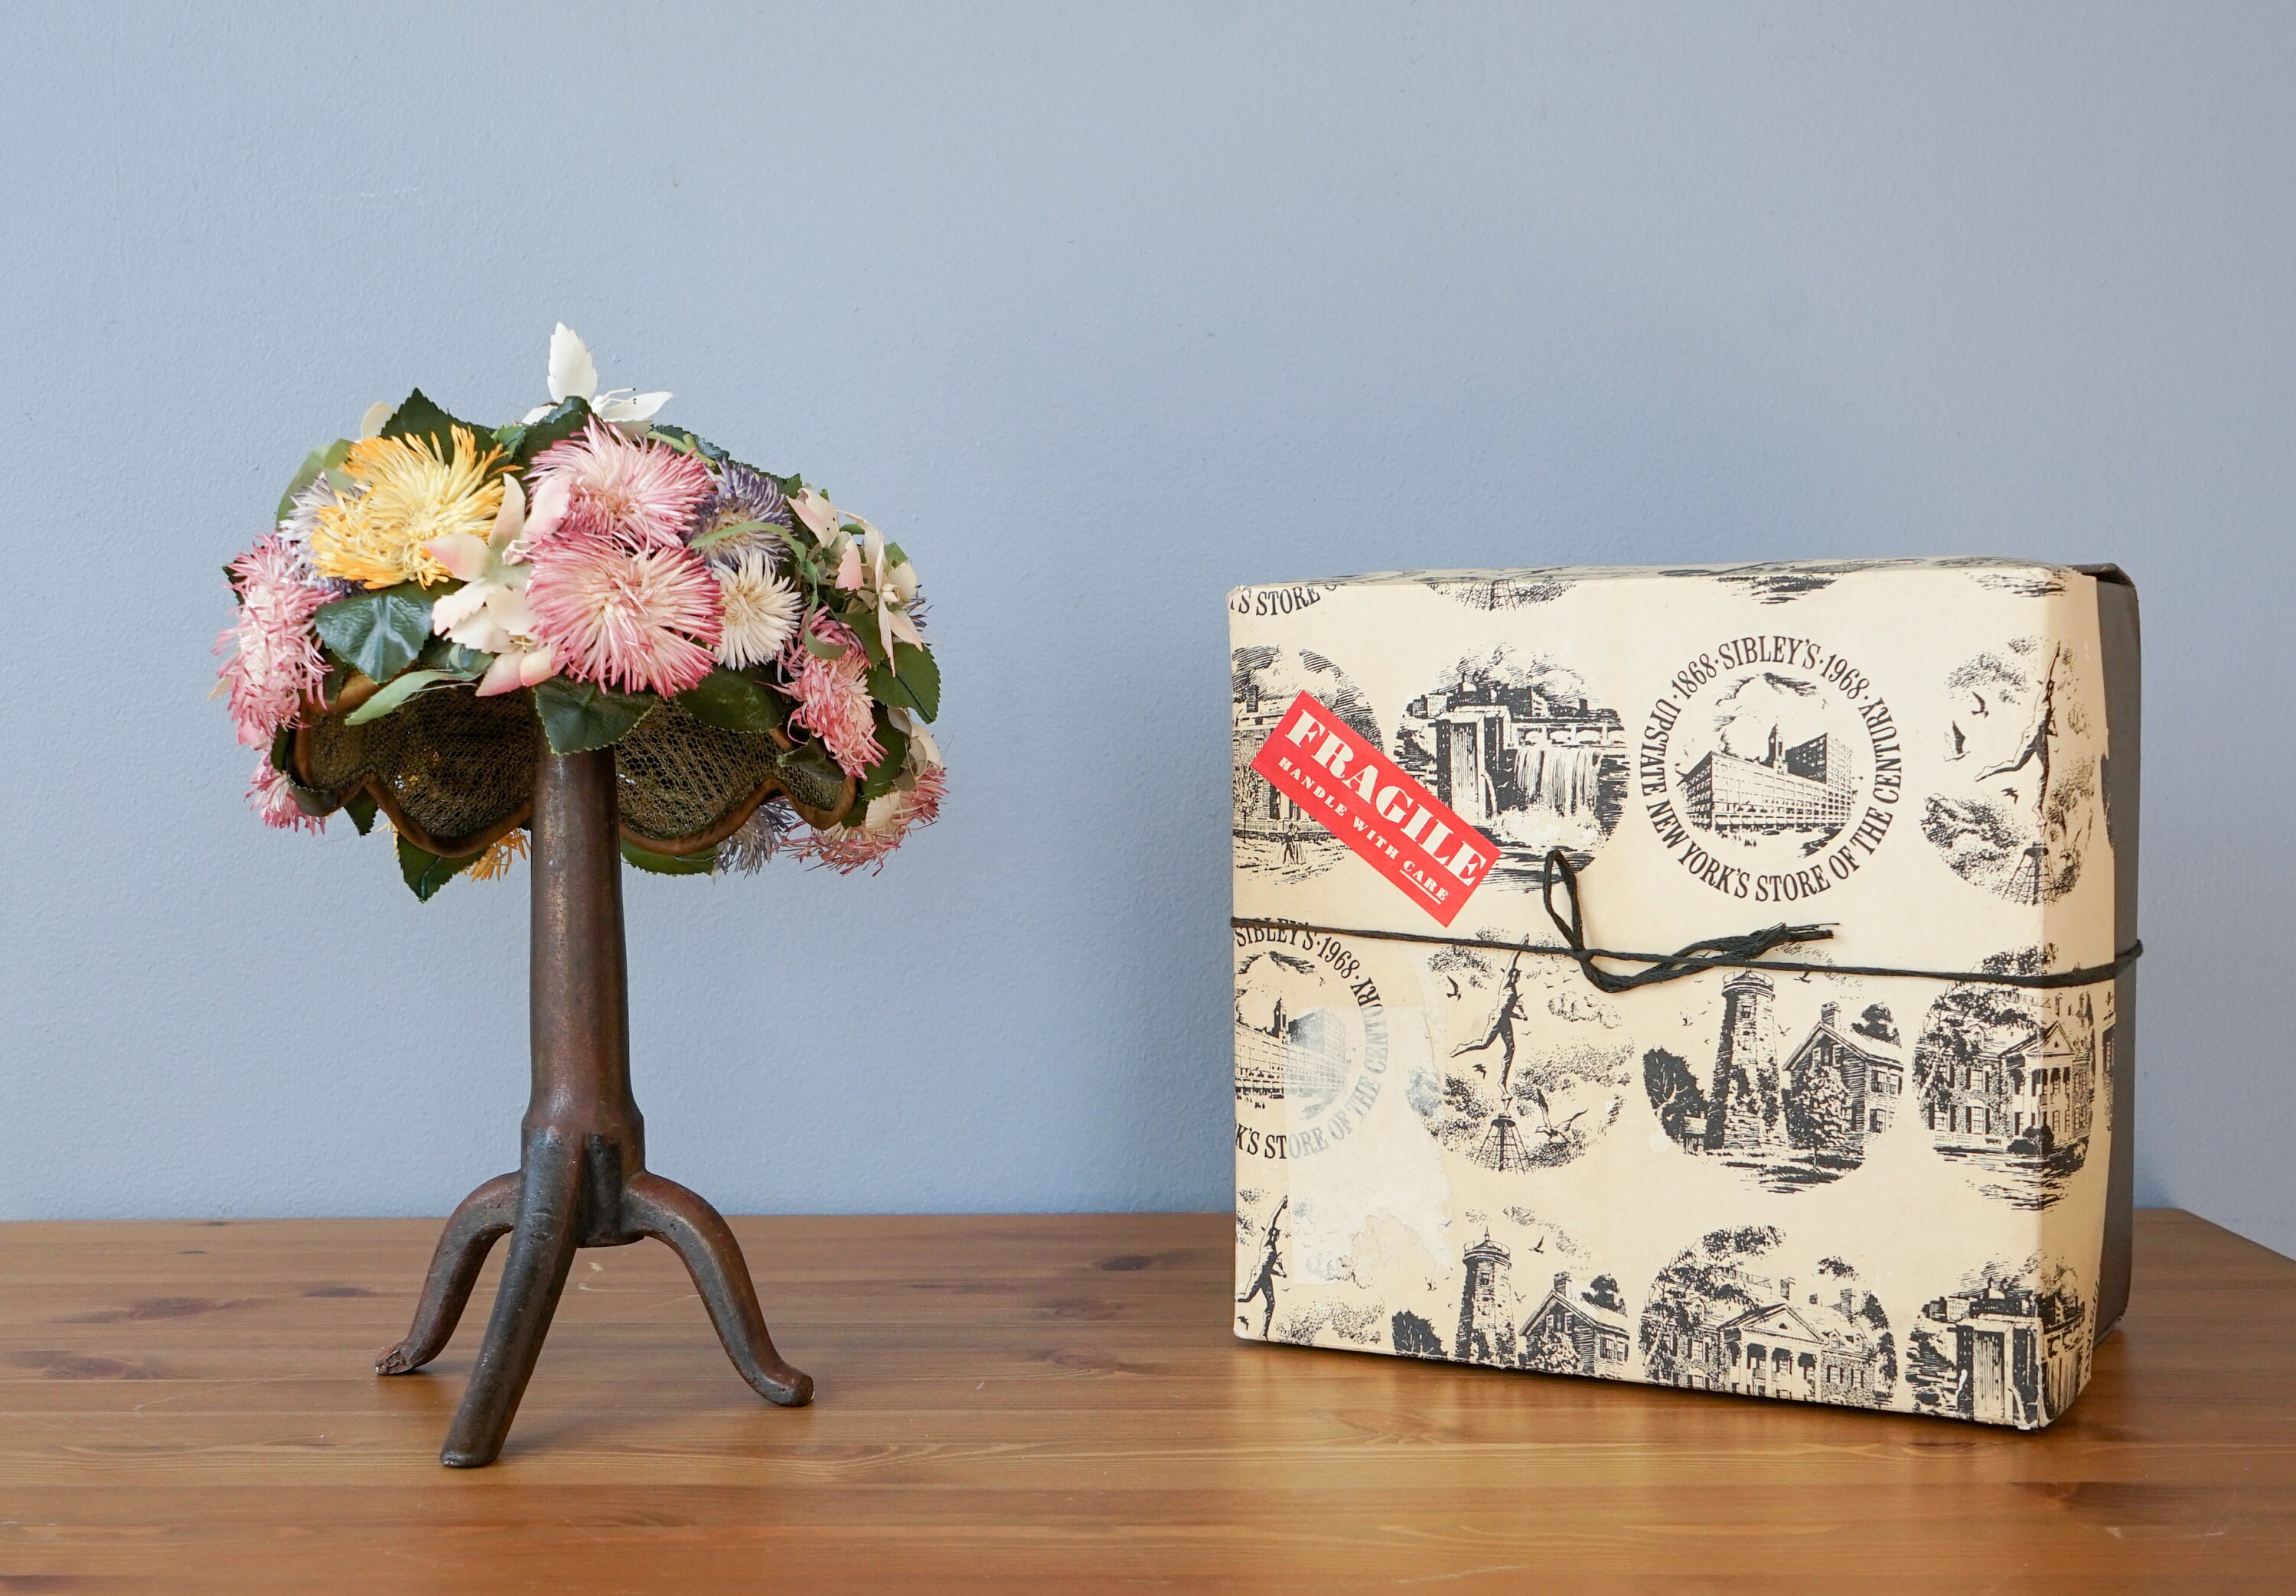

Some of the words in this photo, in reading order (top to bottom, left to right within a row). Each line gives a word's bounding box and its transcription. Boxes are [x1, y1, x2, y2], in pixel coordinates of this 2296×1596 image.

[1256, 586, 1321, 616] STORE
[1671, 653, 1718, 699] 1868
[1718, 636, 1821, 670] SIBLEY'S
[1820, 653, 1870, 700] 1968
[1640, 699, 1681, 796] UPSTATE
[1858, 697, 1902, 804] CENTURY
[1284, 710, 1487, 888] FRAGILE
[1645, 799, 1691, 848] NEW
[1278, 756, 1348, 817] HANDLE
[1353, 820, 1400, 864] WITH
[1402, 860, 1450, 901] CARE
[1850, 806, 1893, 855] THE
[1678, 841, 1750, 899] YORK'S
[1755, 865, 1831, 902] STORE
[1828, 845, 1861, 880] OF
[1317, 936, 1360, 979] 1968
[1350, 977, 1389, 1074] CENTURY
[1345, 1075, 1382, 1122] THE
[1264, 1126, 1330, 1159] STORE
[1327, 1111, 1354, 1141] OF
